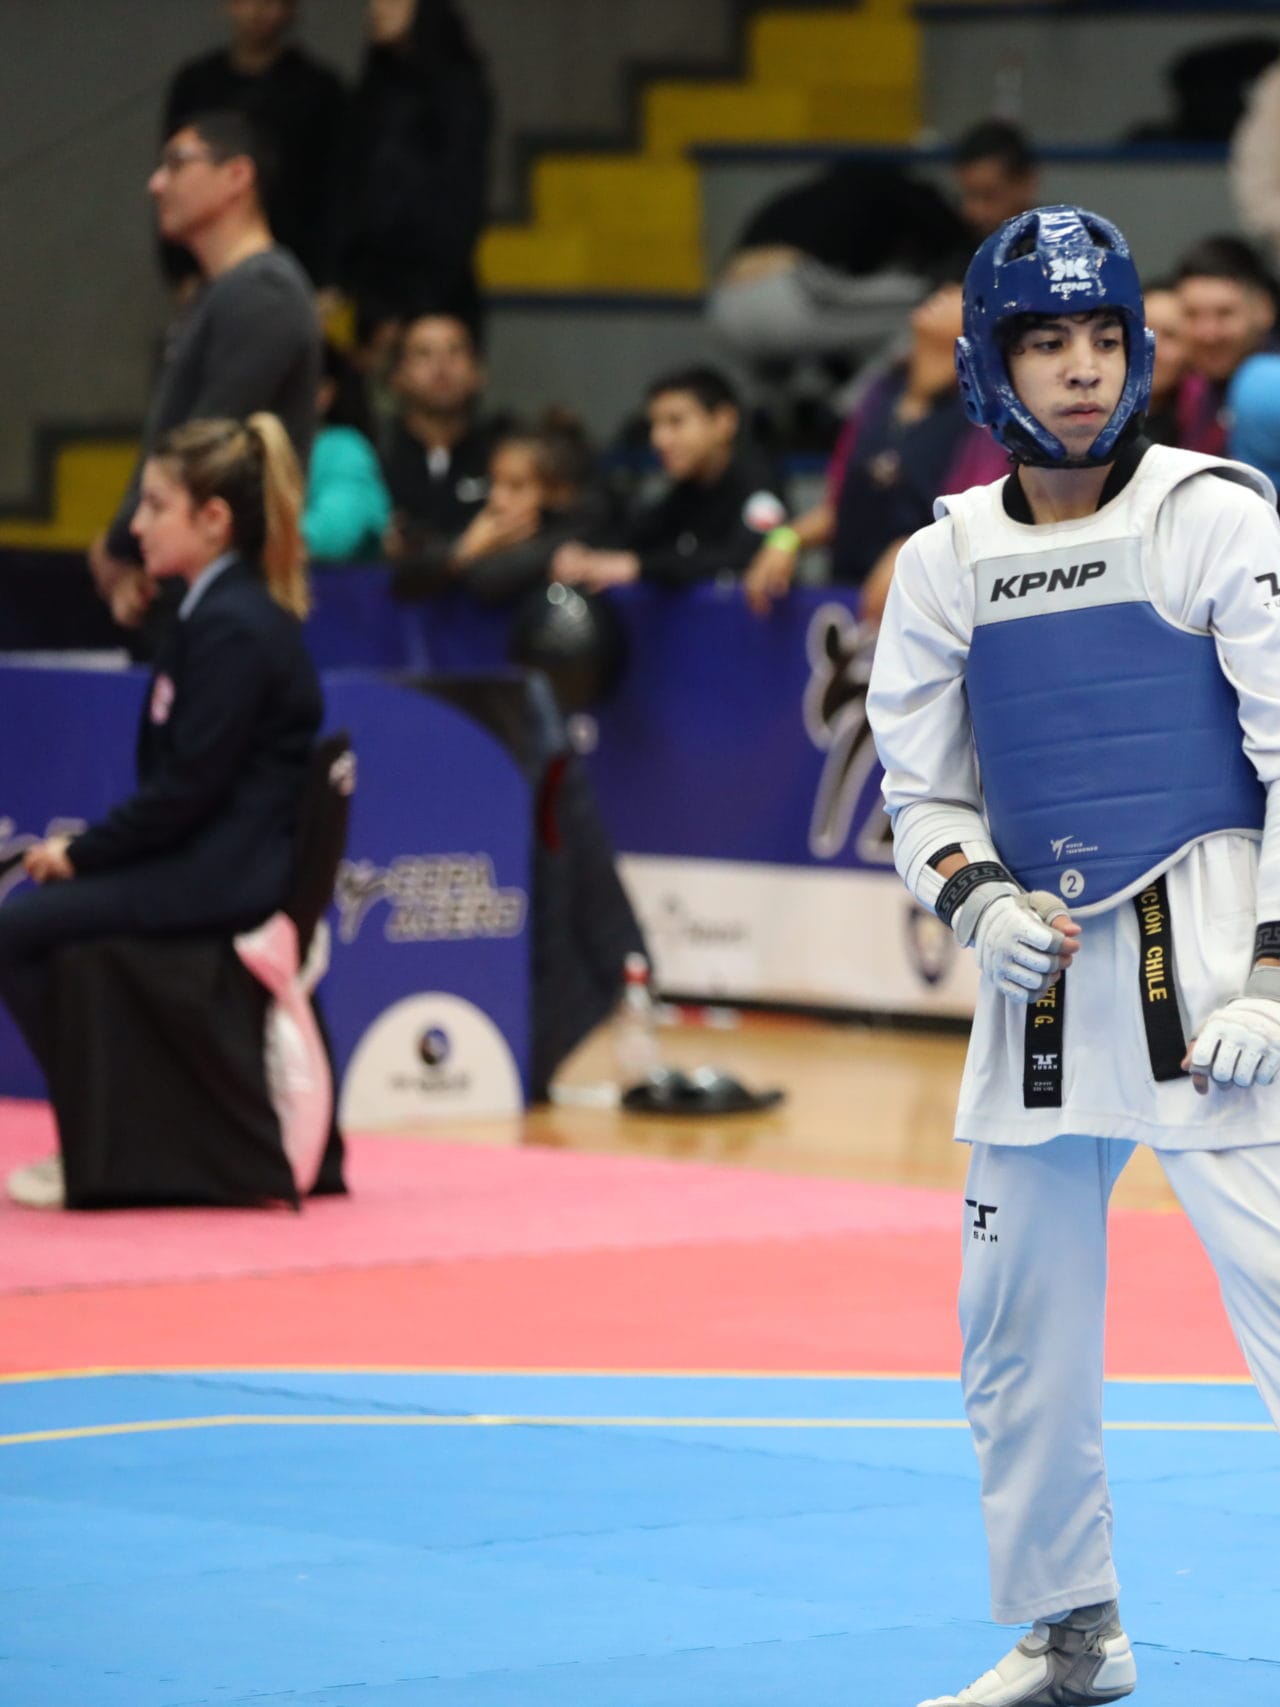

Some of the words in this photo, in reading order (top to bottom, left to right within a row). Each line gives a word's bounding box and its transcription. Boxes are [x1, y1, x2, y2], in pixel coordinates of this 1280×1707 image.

[1050, 281, 1092, 293] KPNP
[990, 561, 1106, 602] KPNP
[1067, 875, 1077, 893] 2
[1145, 946, 1168, 1002] CHILE
[1034, 1015, 1054, 1028] G.
